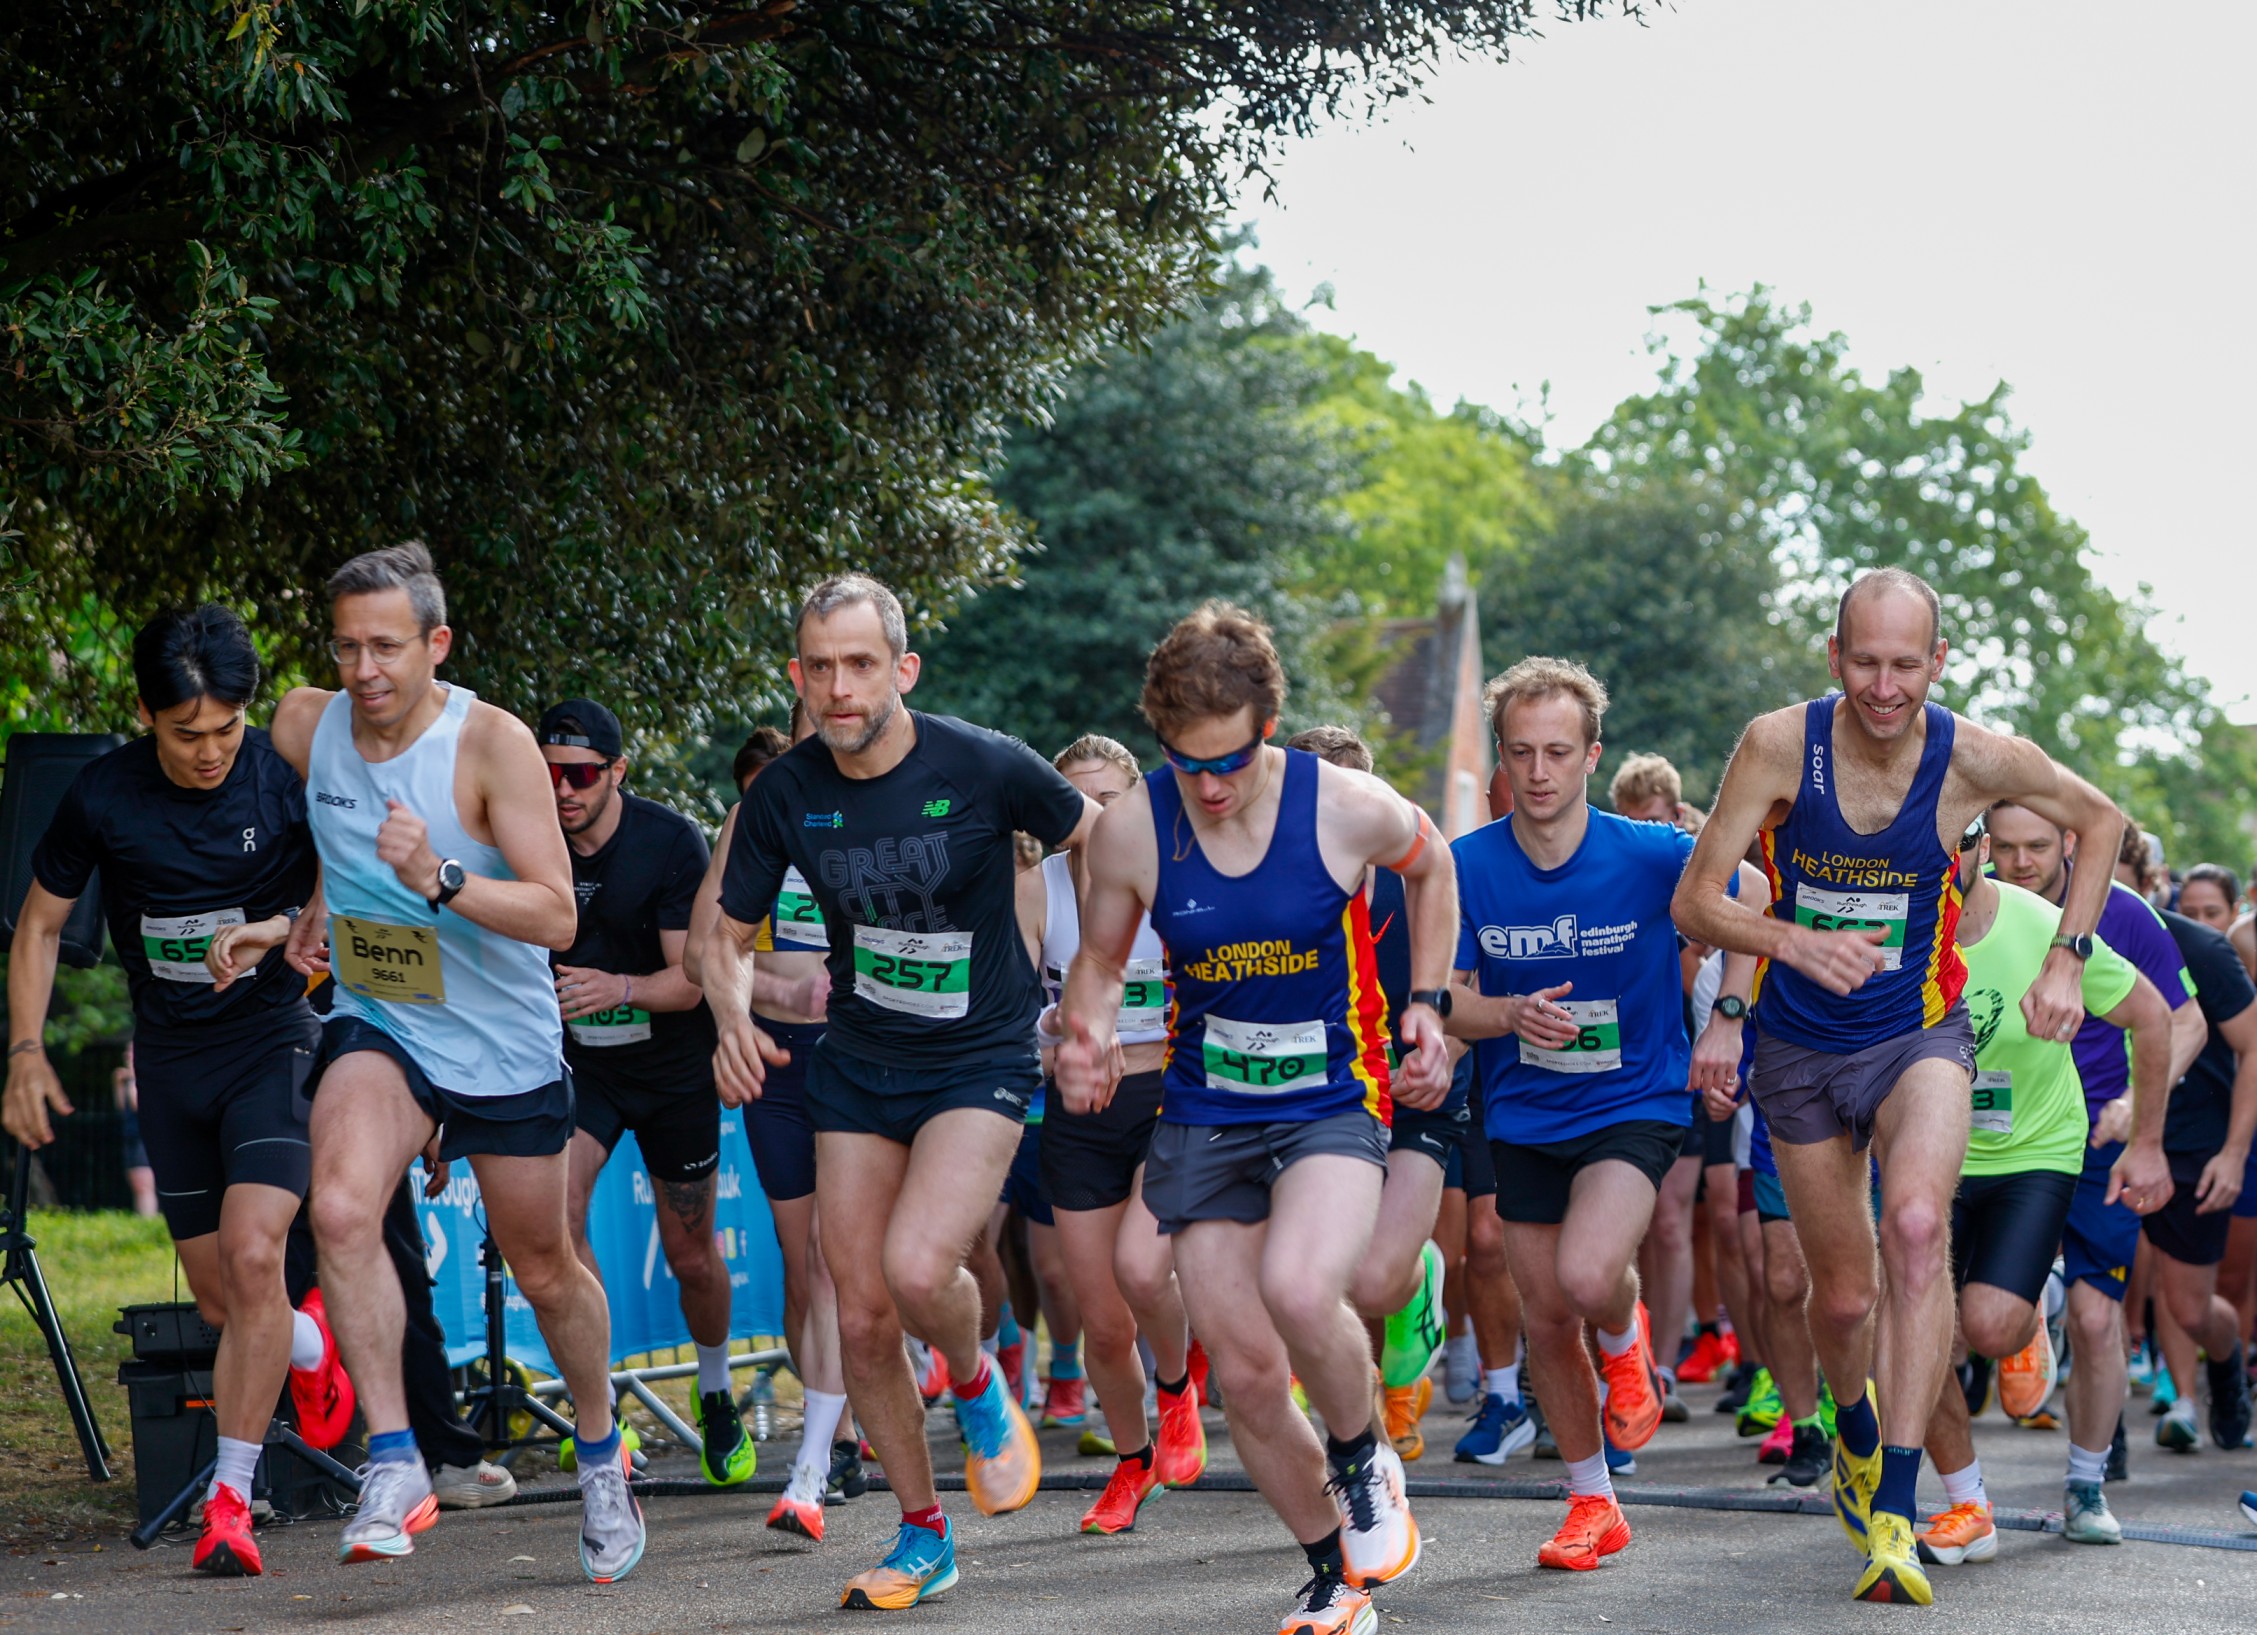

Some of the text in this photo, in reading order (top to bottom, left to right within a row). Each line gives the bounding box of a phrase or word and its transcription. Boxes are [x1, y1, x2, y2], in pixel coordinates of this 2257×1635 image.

[1812, 743, 1825, 795] soar
[316, 792, 357, 809] BROOKS
[820, 830, 950, 889] GREAT
[1791, 848, 1919, 887] HEATHSIDE
[1822, 851, 1889, 869] LONDON
[1477, 914, 1578, 960] emf
[1580, 920, 1638, 938] edinburgh
[1581, 932, 1635, 948] marathon
[352, 935, 424, 967] Benn
[1206, 939, 1291, 963] LONDON
[1582, 943, 1624, 957] festival
[371, 967, 407, 983] 9661
[871, 953, 953, 991] 257
[1184, 949, 1319, 982] HEATHSIDE
[1122, 982, 1148, 1007] 3
[1223, 1050, 1306, 1085] 470
